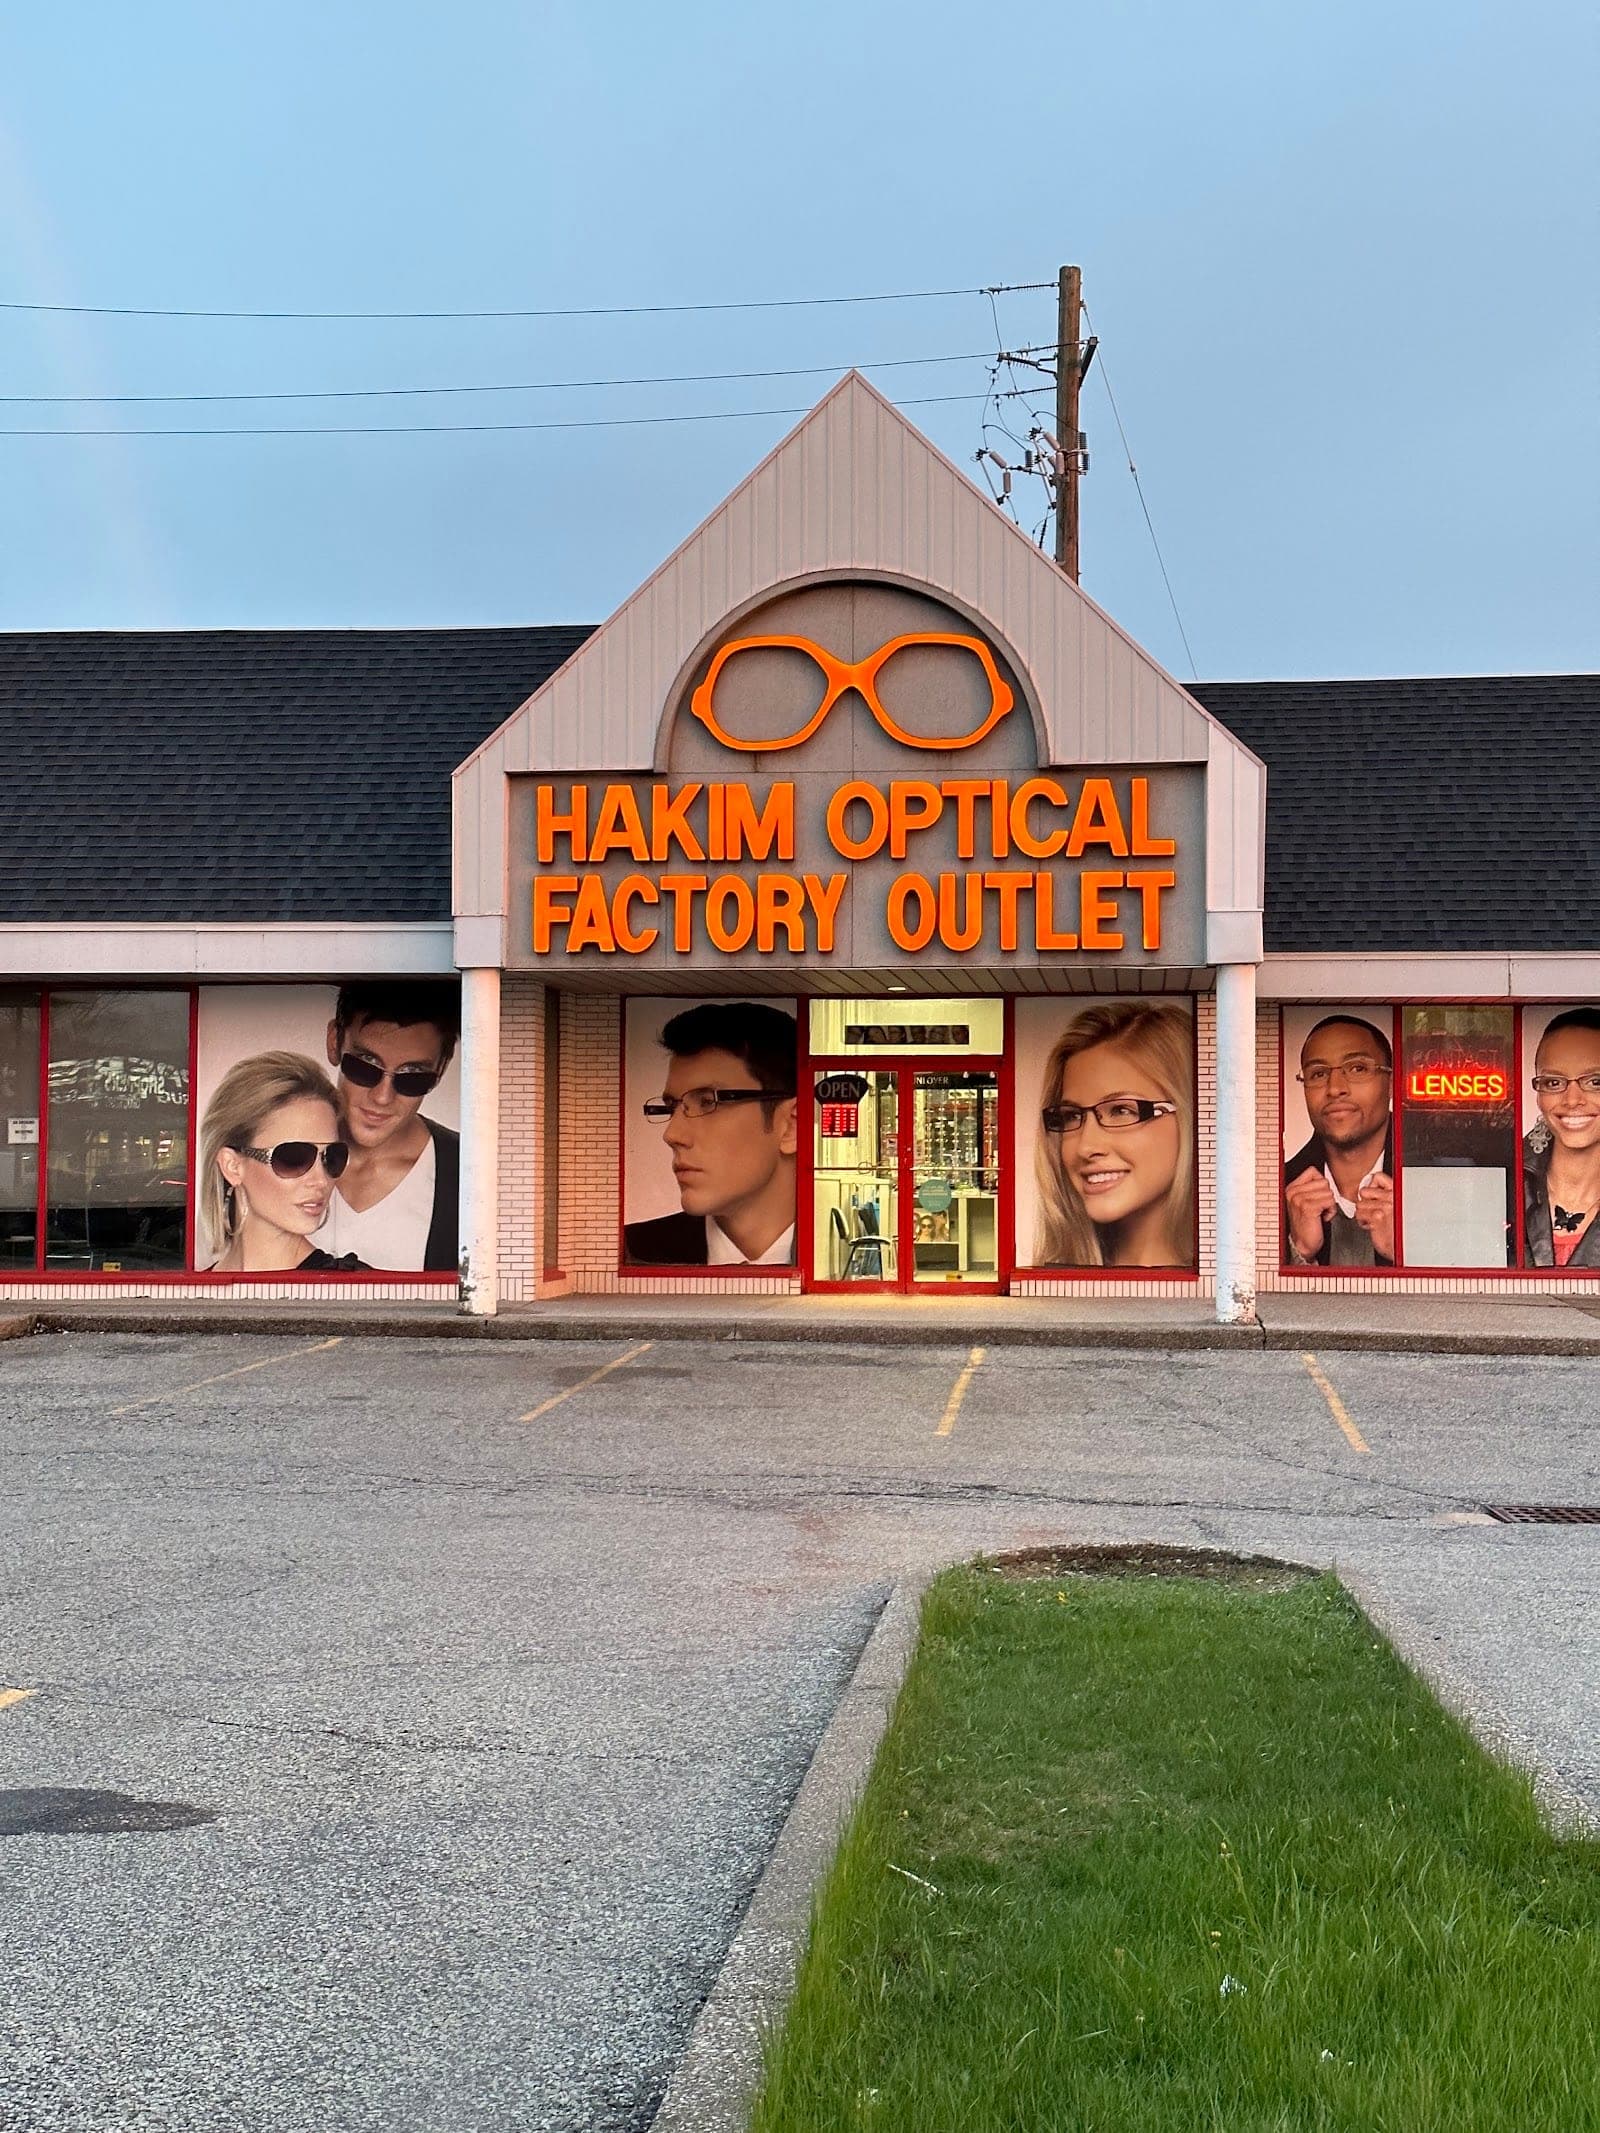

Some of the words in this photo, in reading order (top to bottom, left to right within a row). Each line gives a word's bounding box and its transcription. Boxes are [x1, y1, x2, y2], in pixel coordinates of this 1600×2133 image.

[536, 782, 794, 862] HAKIM
[826, 778, 1176, 859] OPTICAL
[533, 873, 847, 953] FACTORY
[887, 870, 1175, 951] OUTLET
[818, 1081, 860, 1098] OPEN
[1412, 1074, 1503, 1096] LENSES
